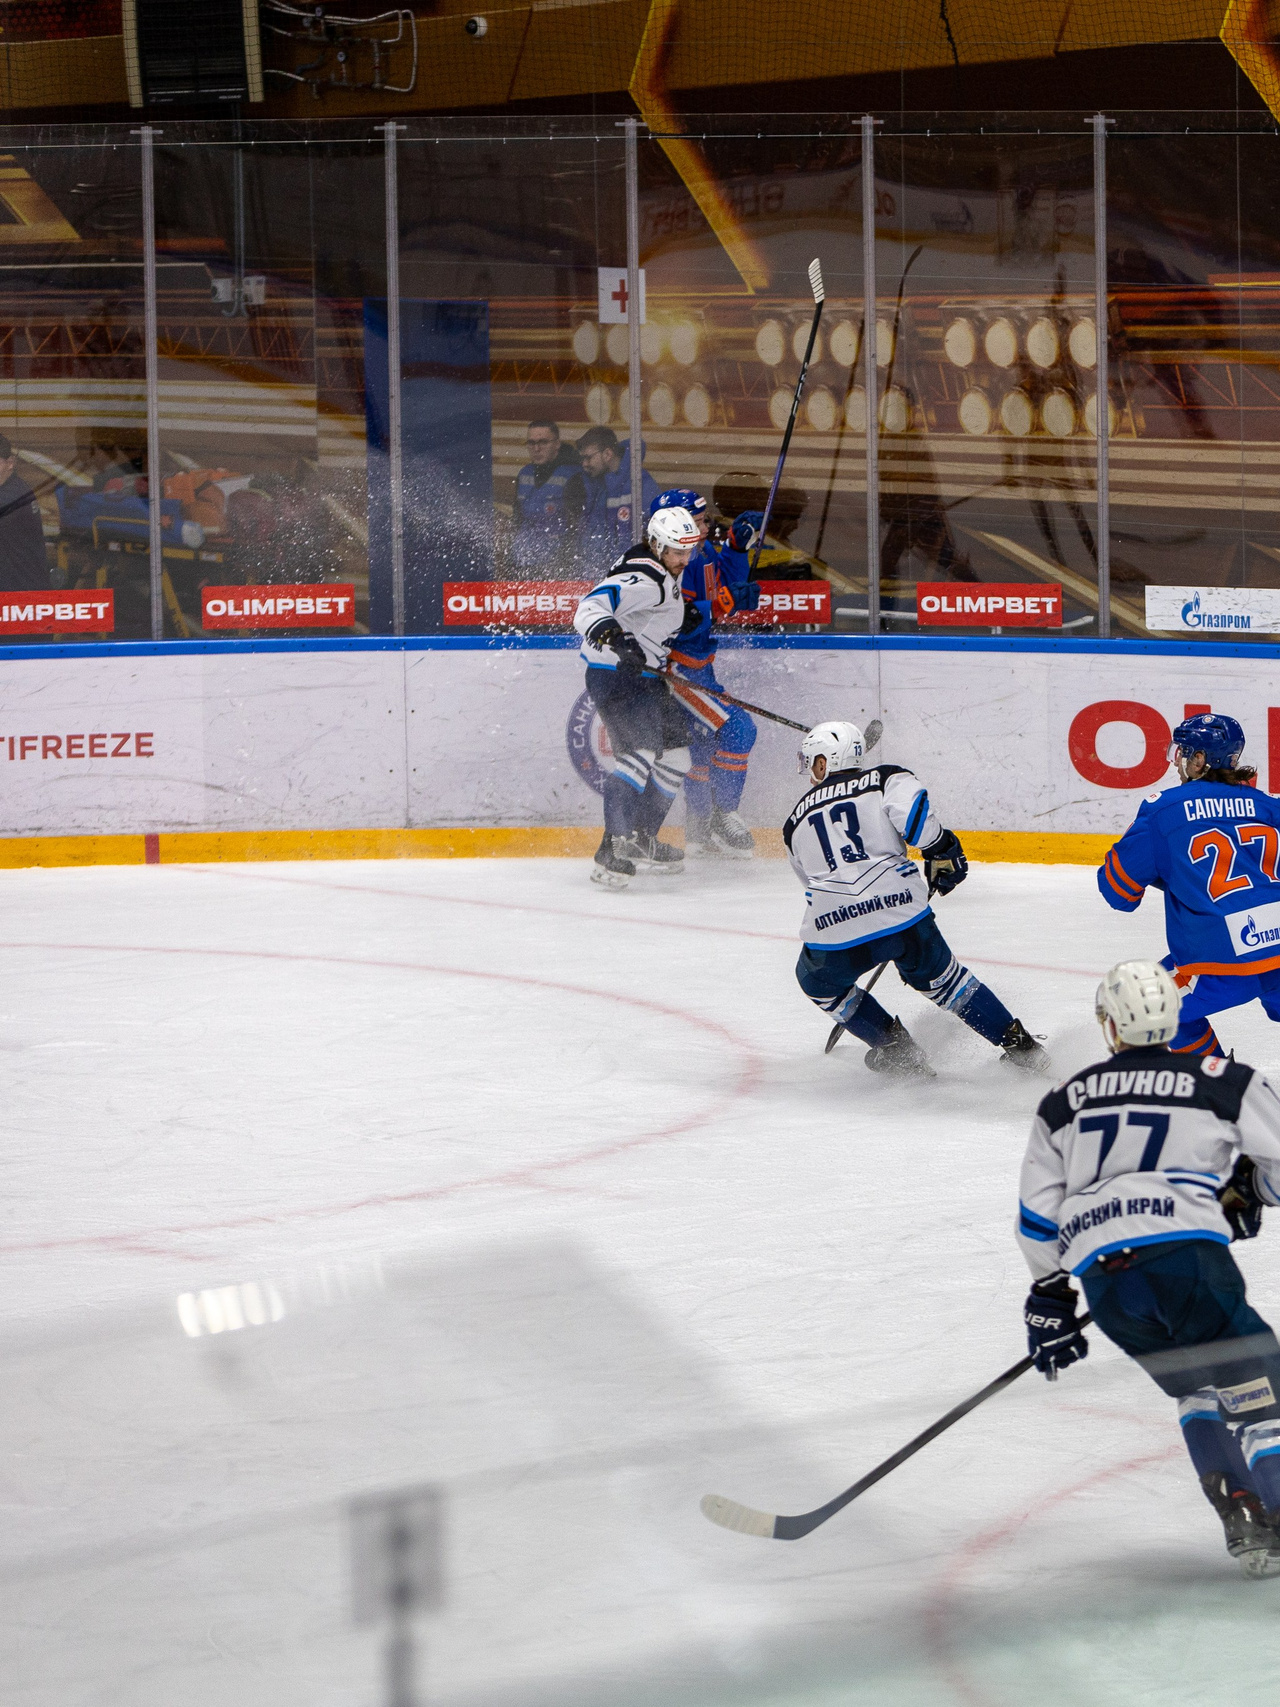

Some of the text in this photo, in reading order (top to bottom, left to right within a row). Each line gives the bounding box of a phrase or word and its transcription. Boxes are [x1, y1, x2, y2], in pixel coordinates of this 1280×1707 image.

[0, 602, 110, 622] IMPBET
[205, 597, 350, 617] OLIMPBET
[757, 593, 826, 611] PBET
[920, 595, 1058, 614] OLIMPBET
[853, 744, 863, 757] 13
[1183, 798, 1256, 822] САПУНОВ
[807, 801, 871, 874] 13
[814, 888, 913, 932] АЛТАЙСКИЙ КРАЙ
[1146, 1028, 1166, 1043] 77
[1066, 1069, 1197, 1111] САПУНОВ
[1079, 1110, 1172, 1186] 77
[1126, 1195, 1175, 1217] КРАЙ
